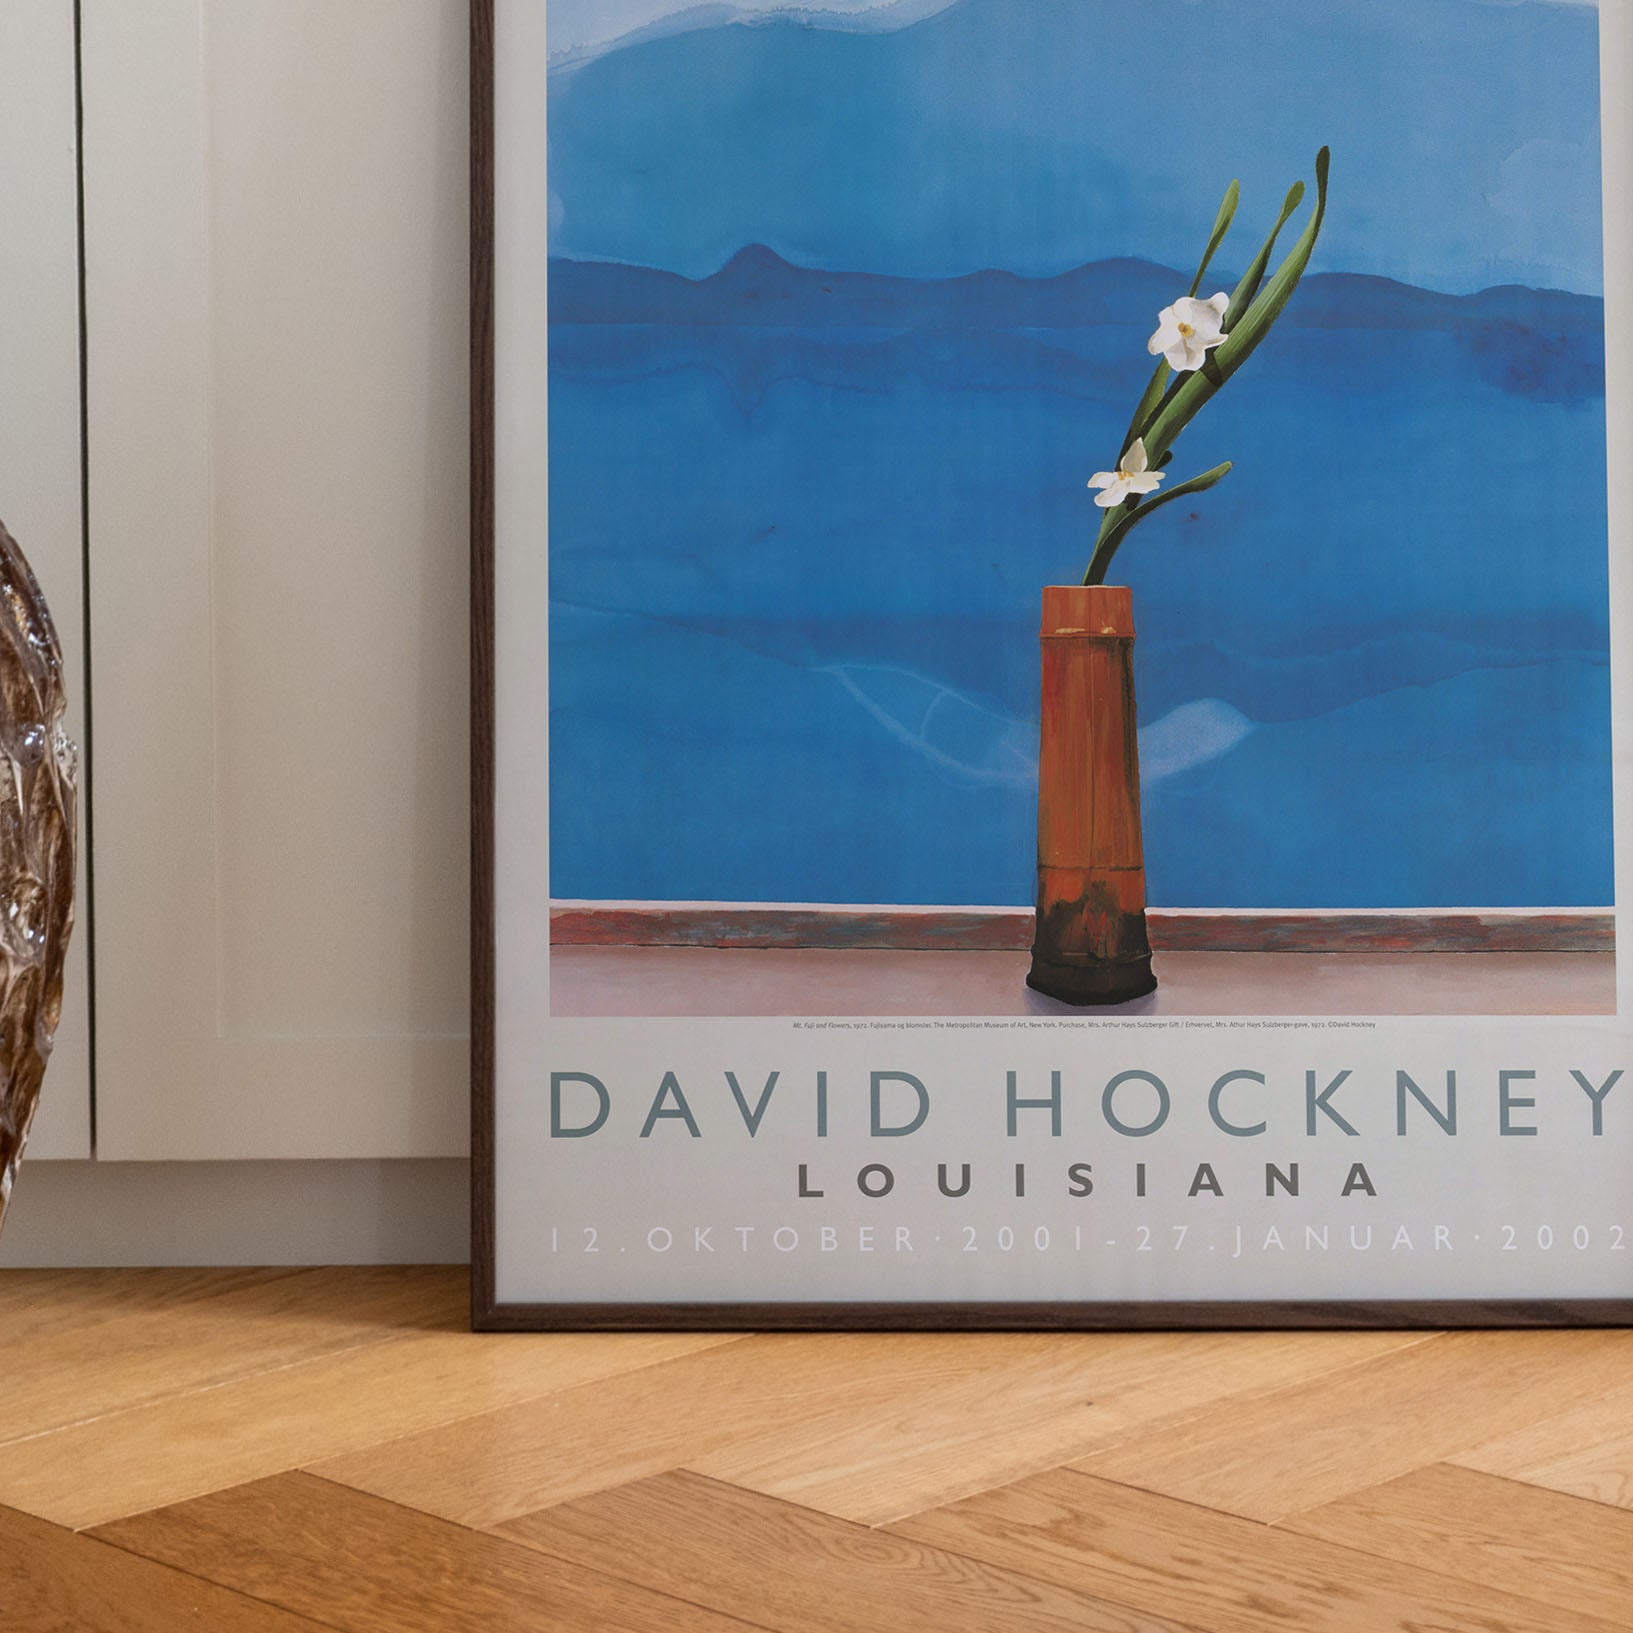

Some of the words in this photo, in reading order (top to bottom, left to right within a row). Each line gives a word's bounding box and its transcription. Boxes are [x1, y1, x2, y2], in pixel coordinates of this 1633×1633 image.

[549, 1070, 931, 1139] DAVID
[1006, 1069, 1625, 1137] HOCKNEY
[798, 1162, 1378, 1198] LOUISIANA
